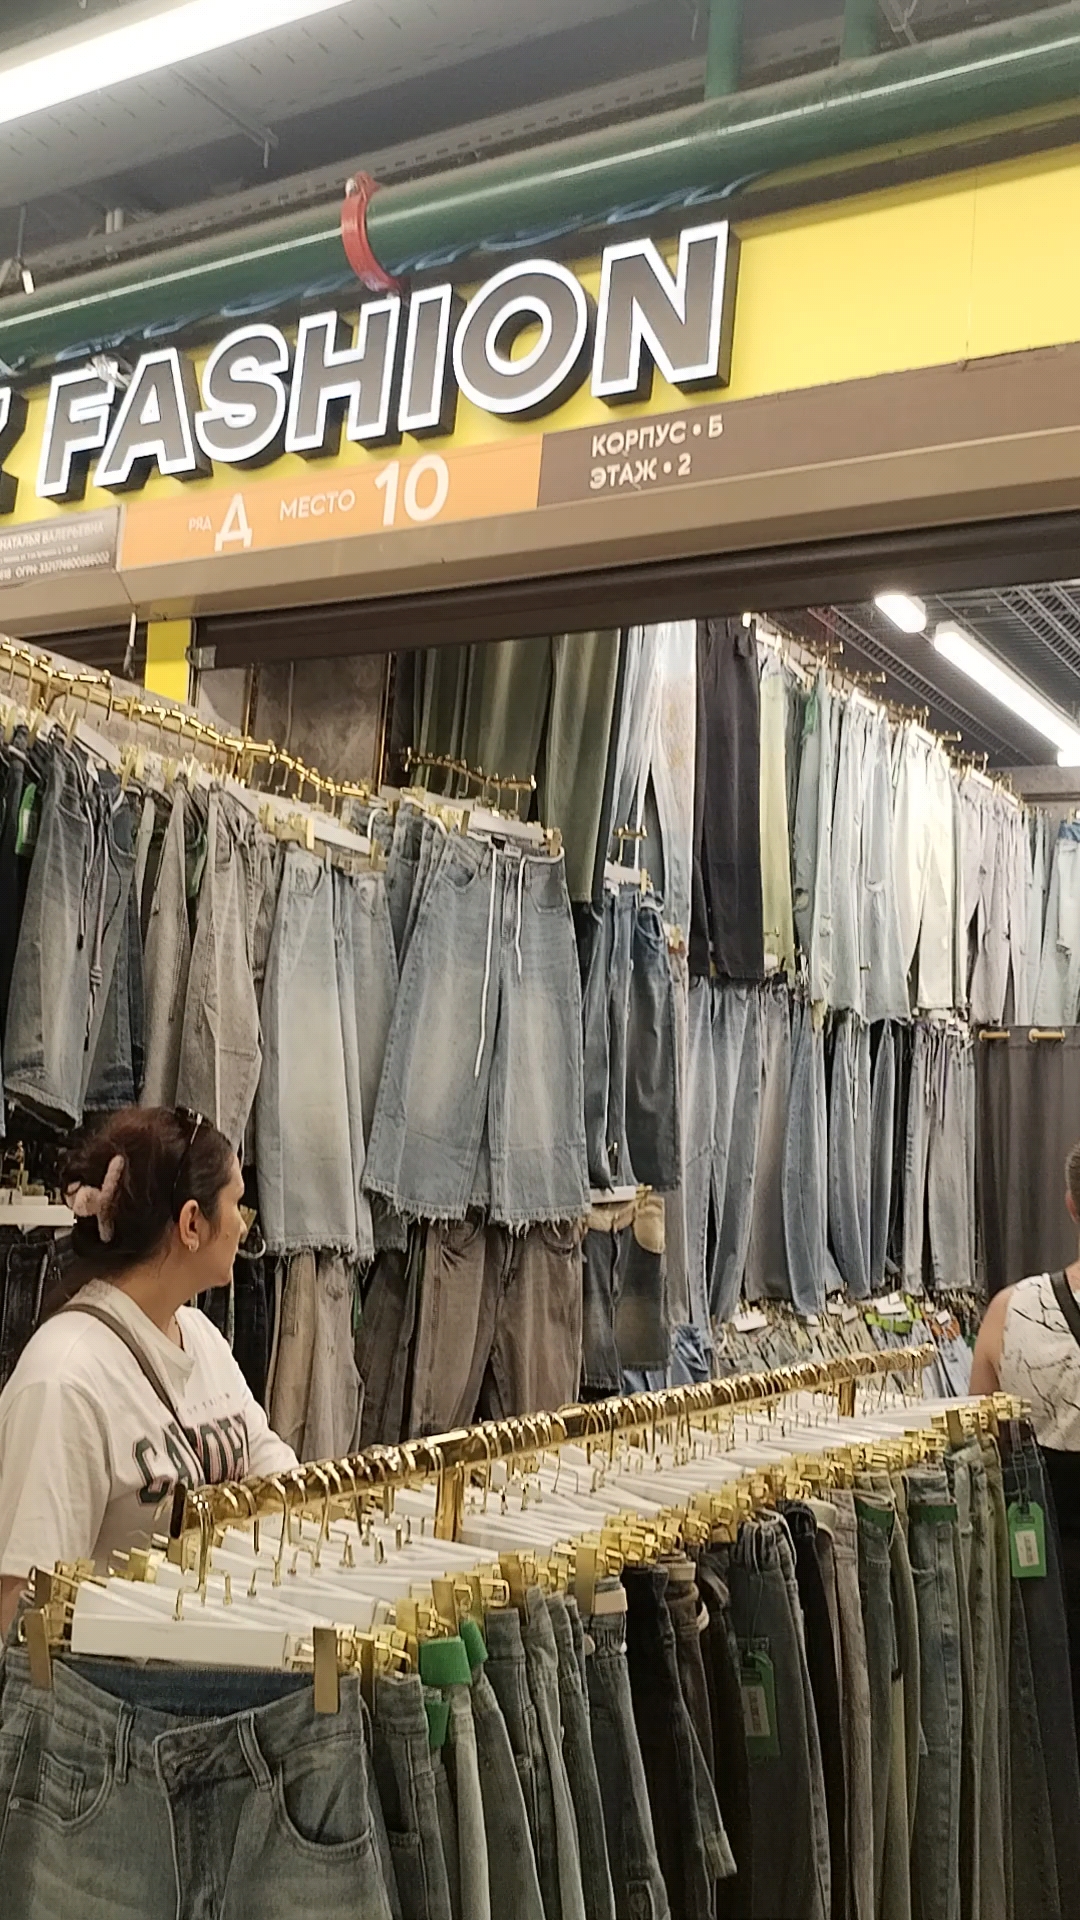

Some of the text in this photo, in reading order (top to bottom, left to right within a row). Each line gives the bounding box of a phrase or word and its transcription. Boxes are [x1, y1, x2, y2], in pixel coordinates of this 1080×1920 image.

[37, 221, 732, 499] FASHION
[589, 452, 692, 489] ЭТАЖ 2
[591, 413, 724, 458] КОРПУС Б
[188, 453, 449, 552] РЯД Д МЕСТО 10
